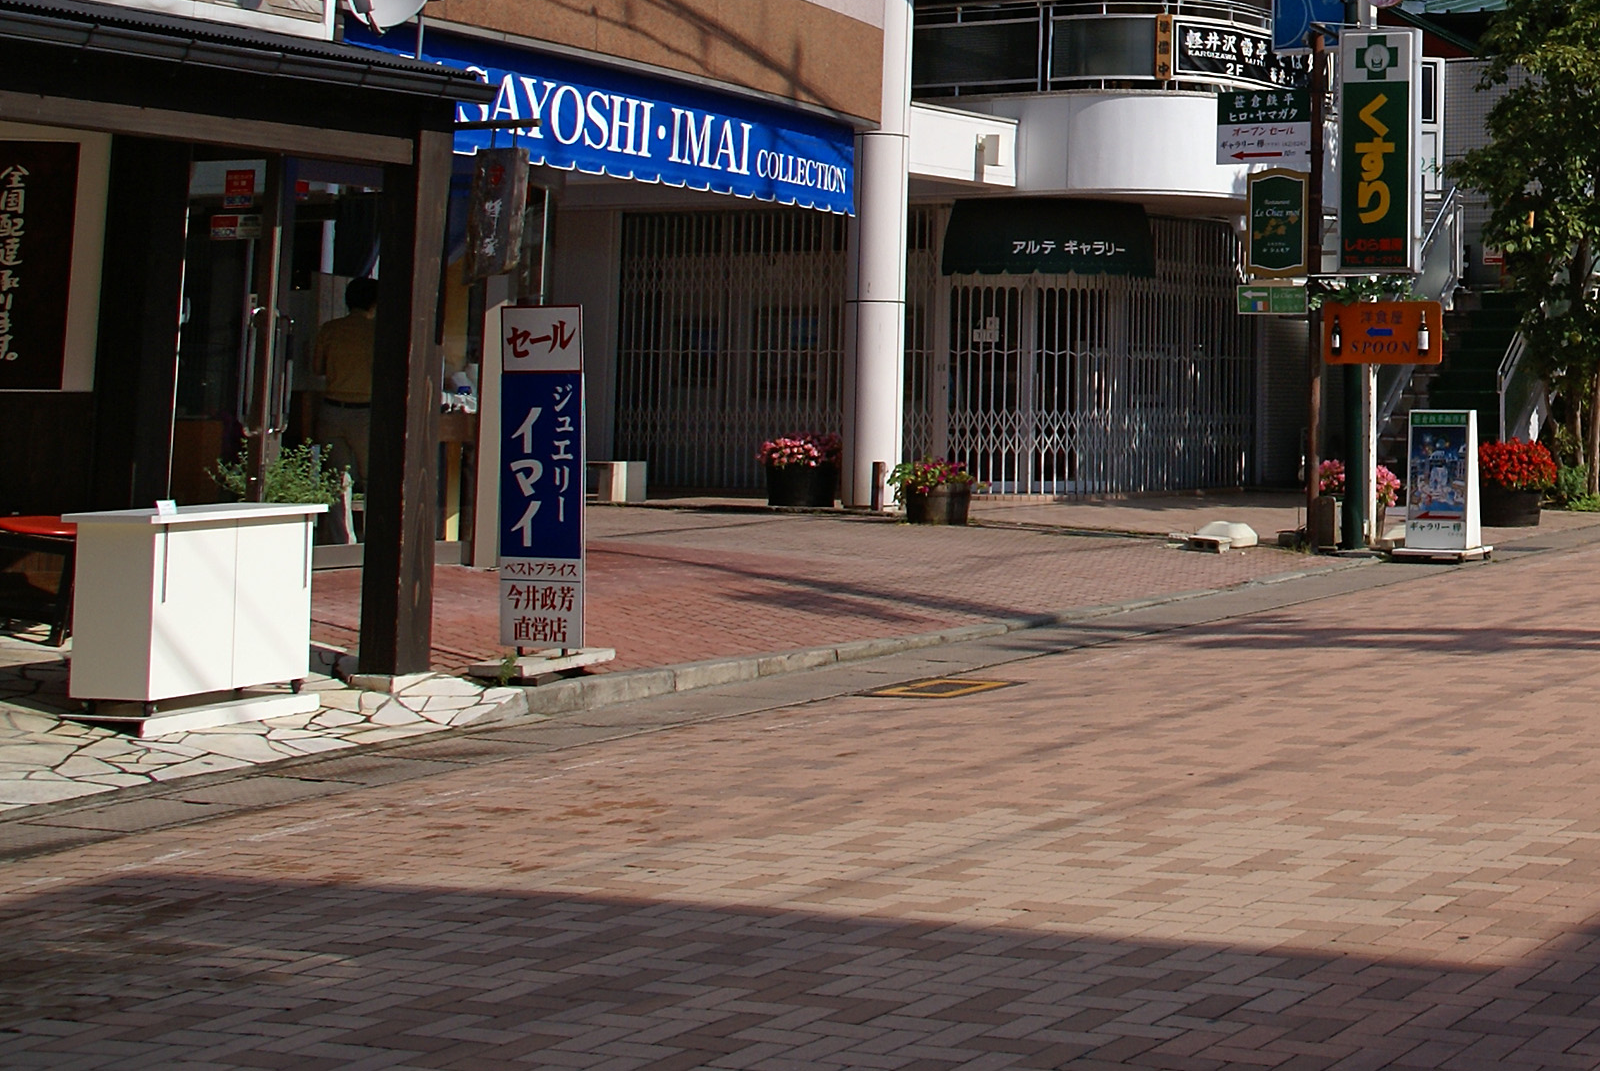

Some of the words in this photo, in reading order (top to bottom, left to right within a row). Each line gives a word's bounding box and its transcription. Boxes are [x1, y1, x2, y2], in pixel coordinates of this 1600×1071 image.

[1226, 63, 1244, 76] 2F
[757, 148, 846, 195] COLLECTION
[1355, 93, 1395, 224] くすり
[1254, 209, 1264, 218] Le
[1265, 206, 1284, 218] Chez
[1012, 240, 1056, 255] アルテ
[1064, 240, 1126, 256] ギャラリー
[1361, 309, 1404, 325] 洋食屋
[506, 320, 576, 359] セール
[1350, 340, 1412, 354] SPOON
[553, 384, 574, 523] ジュエリー
[511, 407, 543, 547] イマイ
[1409, 522, 1449, 532] ギャラリー
[506, 584, 575, 613] 今井政芳
[514, 617, 568, 643] 直営店
